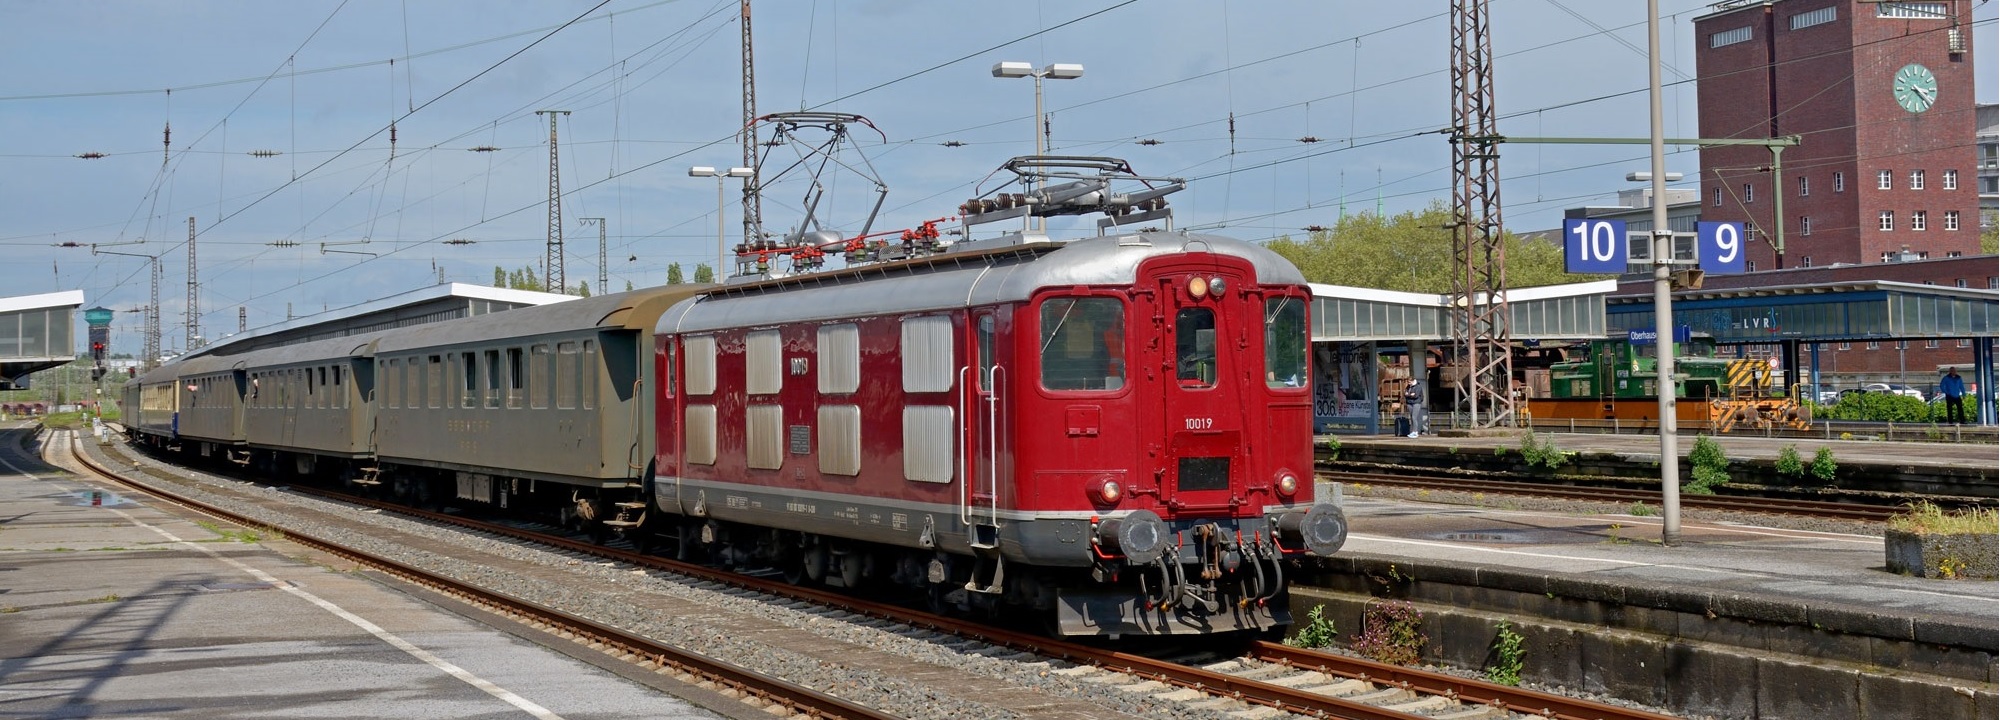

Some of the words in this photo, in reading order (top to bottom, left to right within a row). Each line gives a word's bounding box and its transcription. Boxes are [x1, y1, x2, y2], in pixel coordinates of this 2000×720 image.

[1573, 221, 1615, 262] 10
[1715, 223, 1738, 263] 9
[1743, 317, 1769, 329] LVR
[1630, 331, 1657, 340] Oberhaus
[791, 357, 808, 375] 10019
[1185, 418, 1213, 430] 10019
